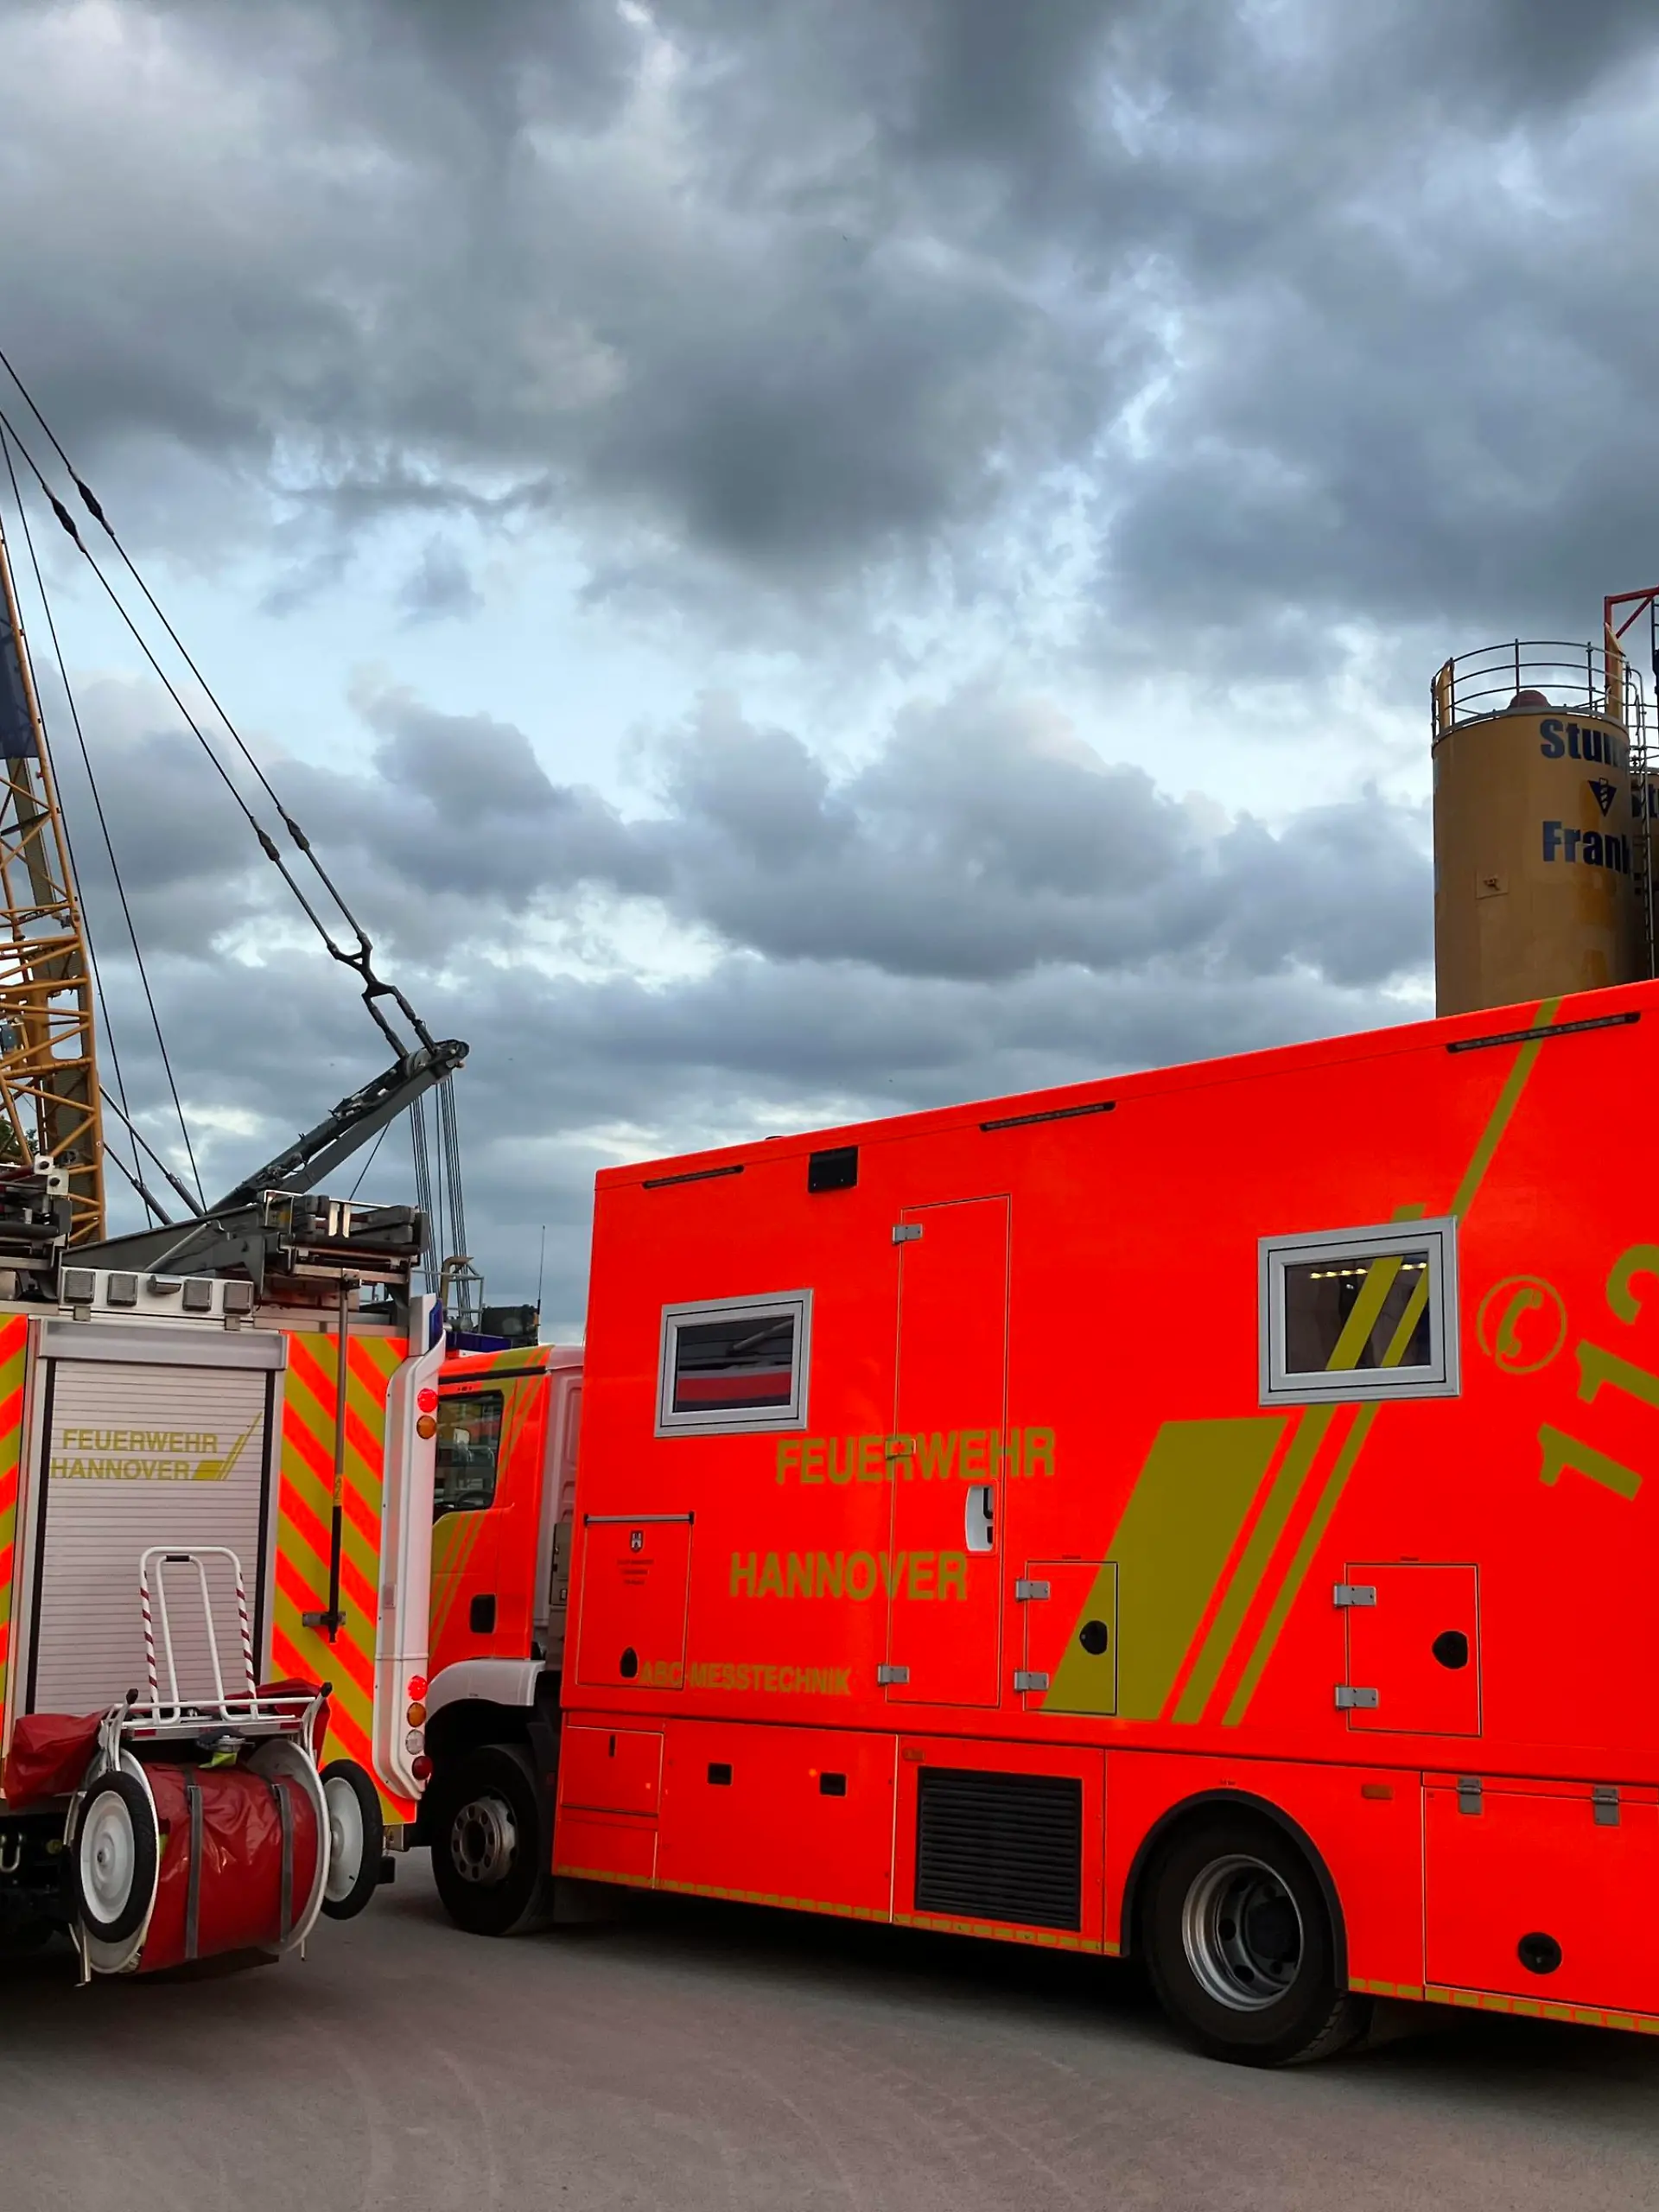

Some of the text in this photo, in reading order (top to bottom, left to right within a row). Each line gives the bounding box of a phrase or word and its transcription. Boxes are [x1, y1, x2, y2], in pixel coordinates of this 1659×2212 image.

[63, 1428, 218, 1453] FEUERWEHR
[776, 1427, 1056, 1484] FEUERWEHR
[50, 1457, 190, 1480] HANNOVER
[729, 1551, 969, 1600] HANNOVER
